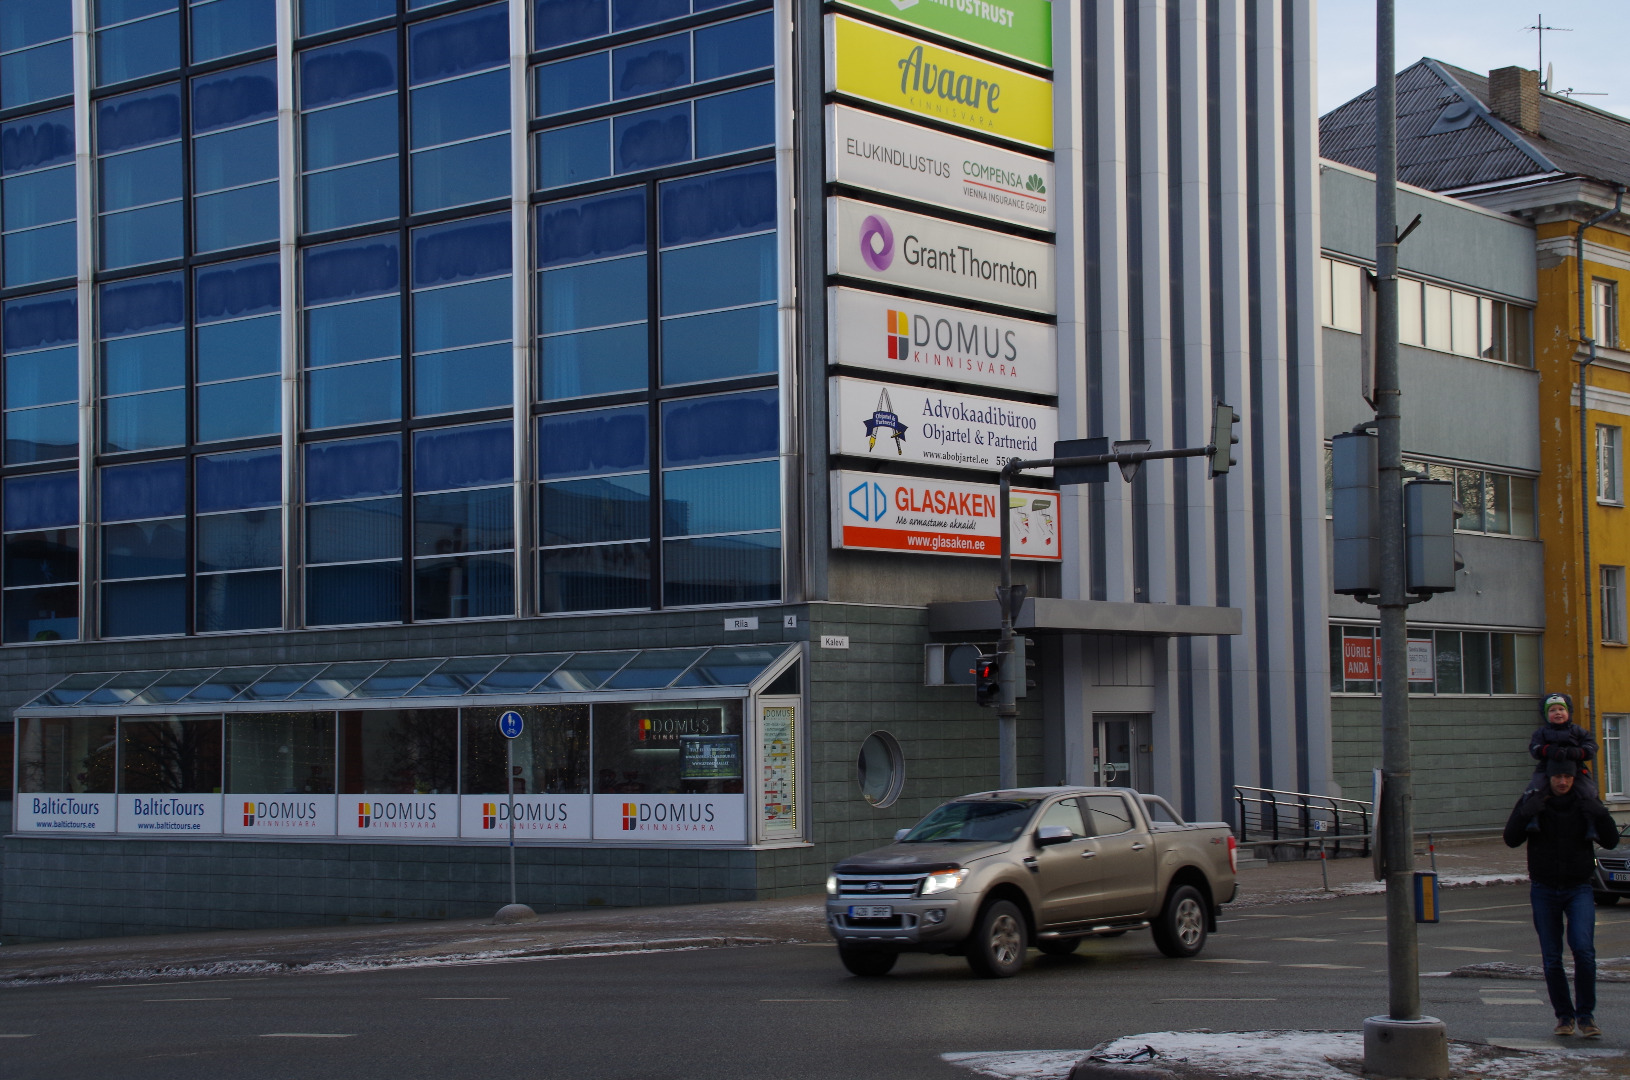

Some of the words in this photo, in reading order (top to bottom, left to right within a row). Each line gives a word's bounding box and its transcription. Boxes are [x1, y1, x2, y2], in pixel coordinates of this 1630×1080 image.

[898, 45, 1000, 114] Avaare
[909, 97, 994, 128] KINNISVARA
[847, 138, 950, 179] ELUKINDLUSTUS
[963, 160, 1024, 190] COMPENSA
[963, 186, 988, 201] VIENNA
[988, 193, 1025, 210] INSURANCE
[1025, 202, 1047, 215] GROUP
[904, 235, 956, 274] Grant
[957, 246, 1037, 290] Thornton
[914, 314, 1018, 362] DOMUS
[914, 350, 1018, 378] KINNISVARA
[922, 398, 1037, 431] Advokaadibüroo
[923, 423, 971, 446] Objartel
[974, 434, 985, 446] &
[987, 432, 1038, 452] Partnerid
[923, 450, 989, 466] www.abobjartel.ee
[895, 486, 996, 518] GLASAKEN
[896, 515, 908, 526] Me
[908, 518, 949, 529] armastame
[949, 519, 977, 530] aknaid!
[907, 535, 986, 551] www.glasaken.ee
[734, 619, 749, 628] Riia
[787, 616, 794, 627] 4
[825, 637, 844, 647] Kalevi
[1345, 643, 1371, 658] ÜÜRILE
[1348, 661, 1370, 674] ANDA
[766, 709, 790, 718] DOMUS
[653, 717, 710, 734] DOMUS
[33, 797, 99, 815] BalticTours
[134, 798, 205, 816] BalticTours
[257, 802, 317, 819] DOMUS
[373, 802, 437, 820] DOMUS
[499, 803, 568, 821] DOMUS
[639, 803, 715, 822] DOMUS
[36, 820, 95, 829] www.baltictours.ee
[138, 821, 201, 830] www.baltictours.ee
[257, 820, 317, 828] KINNISVARA
[373, 821, 437, 829] KINNISVARA
[639, 823, 715, 832] KINNISVARA
